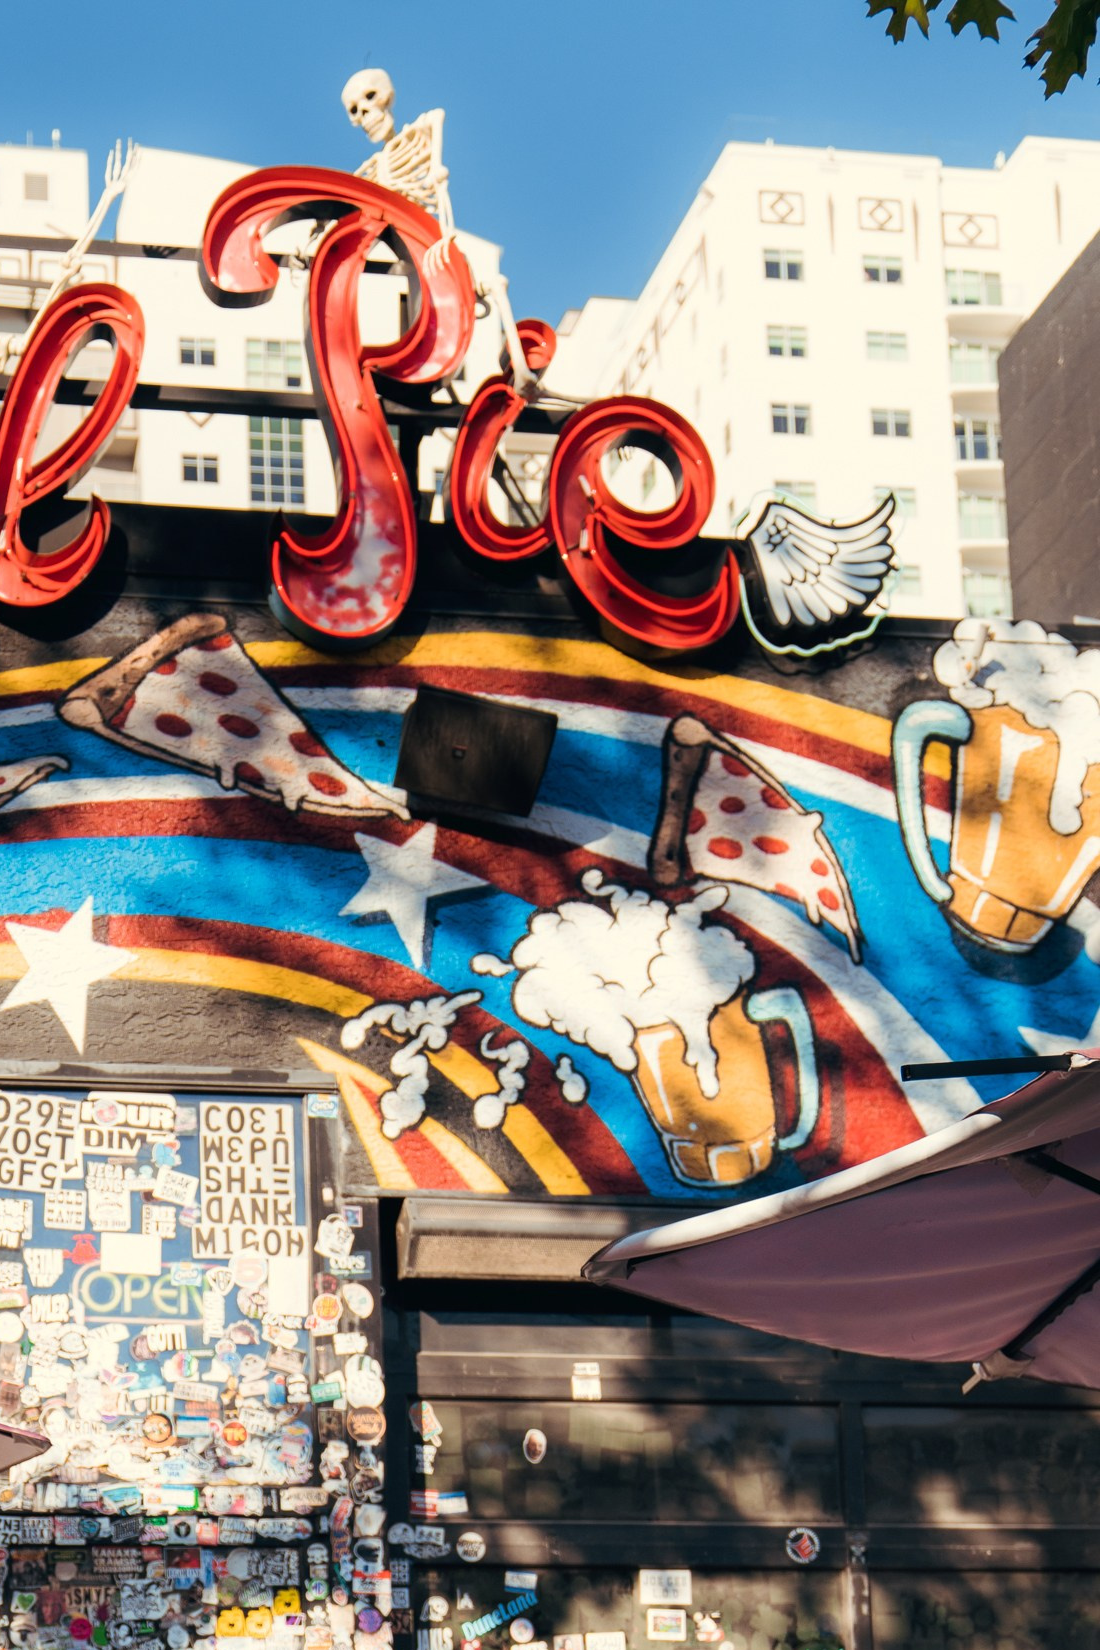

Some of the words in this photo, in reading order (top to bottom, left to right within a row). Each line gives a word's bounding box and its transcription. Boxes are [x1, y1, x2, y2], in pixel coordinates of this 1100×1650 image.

[199, 165, 740, 650] Pie
[80, 1267, 209, 1316] OPEN
[461, 1590, 540, 1642] DuneLand
